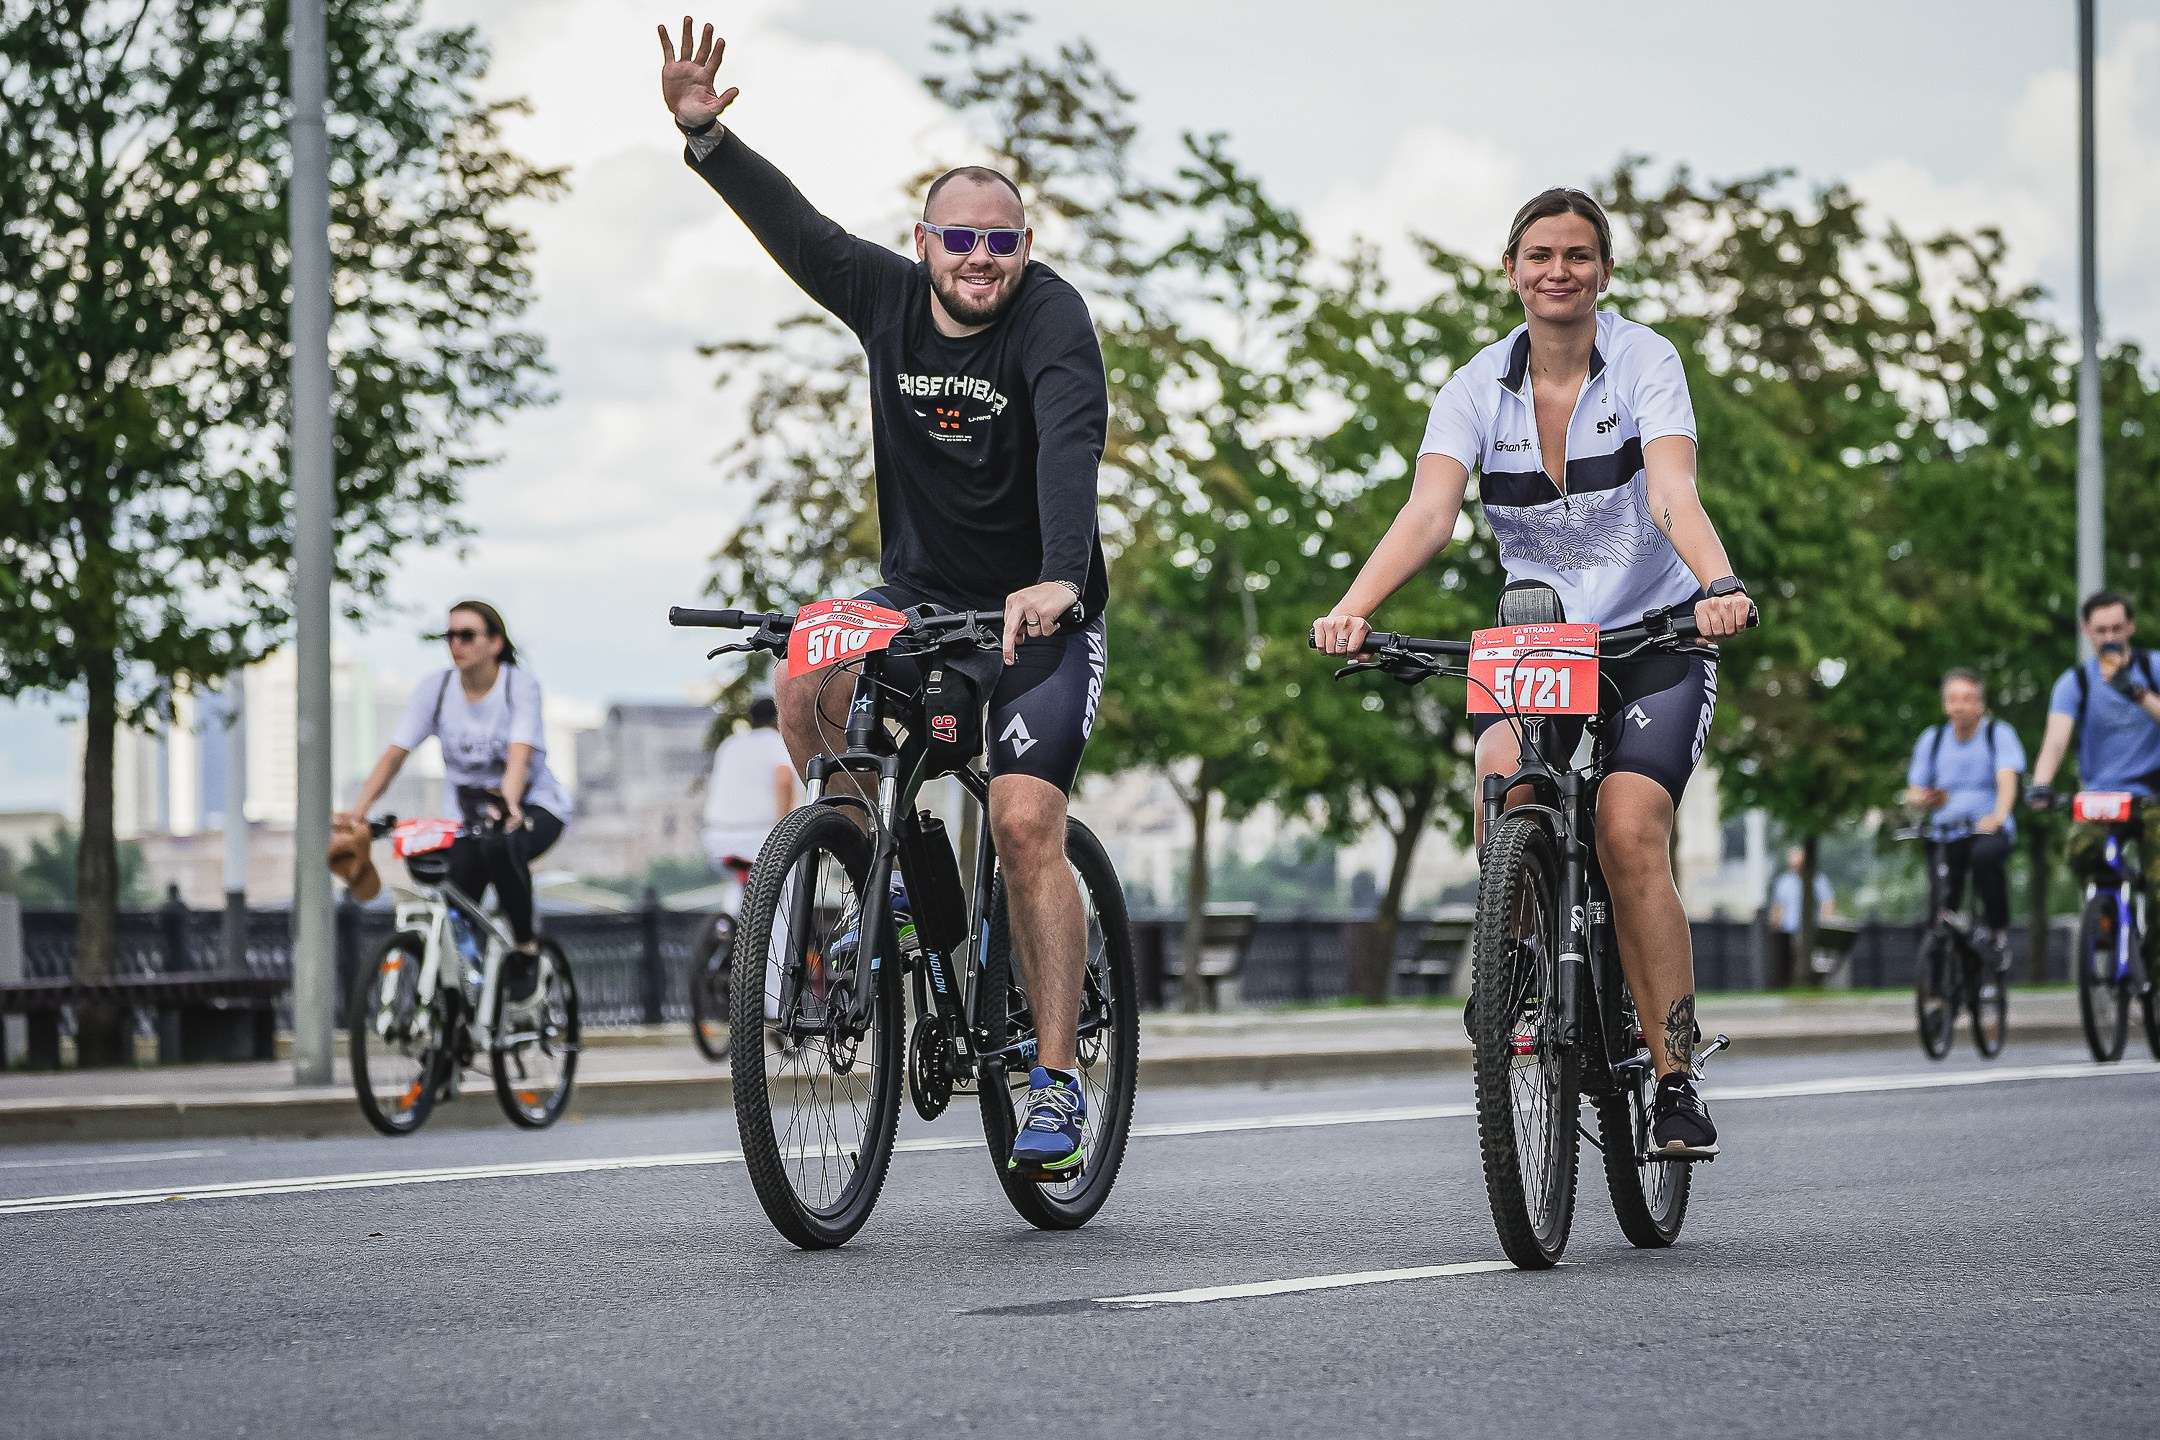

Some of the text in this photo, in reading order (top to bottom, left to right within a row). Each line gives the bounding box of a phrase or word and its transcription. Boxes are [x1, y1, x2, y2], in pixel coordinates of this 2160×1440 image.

[1494, 440, 1520, 453] Gran
[842, 601, 873, 612] STRADA
[1512, 626, 1556, 635] LA STRADA
[1081, 631, 1105, 741] STRAVA
[1494, 667, 1572, 709] 5721
[931, 714, 957, 743] 97
[1691, 658, 1718, 764] STRAVA
[927, 952, 948, 994] MOTION
